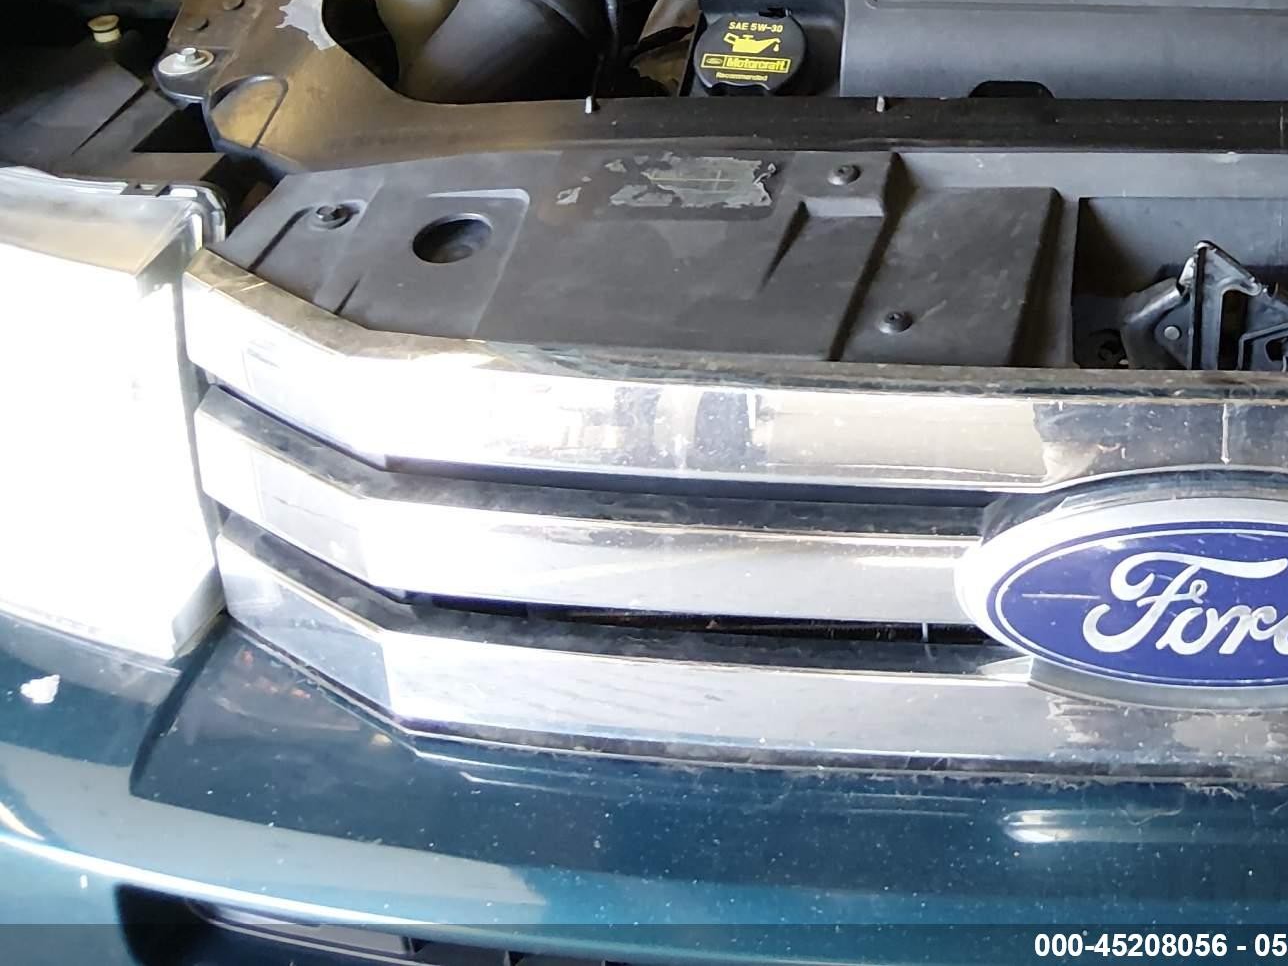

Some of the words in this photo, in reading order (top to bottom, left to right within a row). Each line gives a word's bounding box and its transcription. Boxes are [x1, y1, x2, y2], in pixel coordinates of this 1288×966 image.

[728, 21, 749, 31] SAE
[750, 22, 783, 33] 5W-30
[726, 57, 786, 71] Motorcraft
